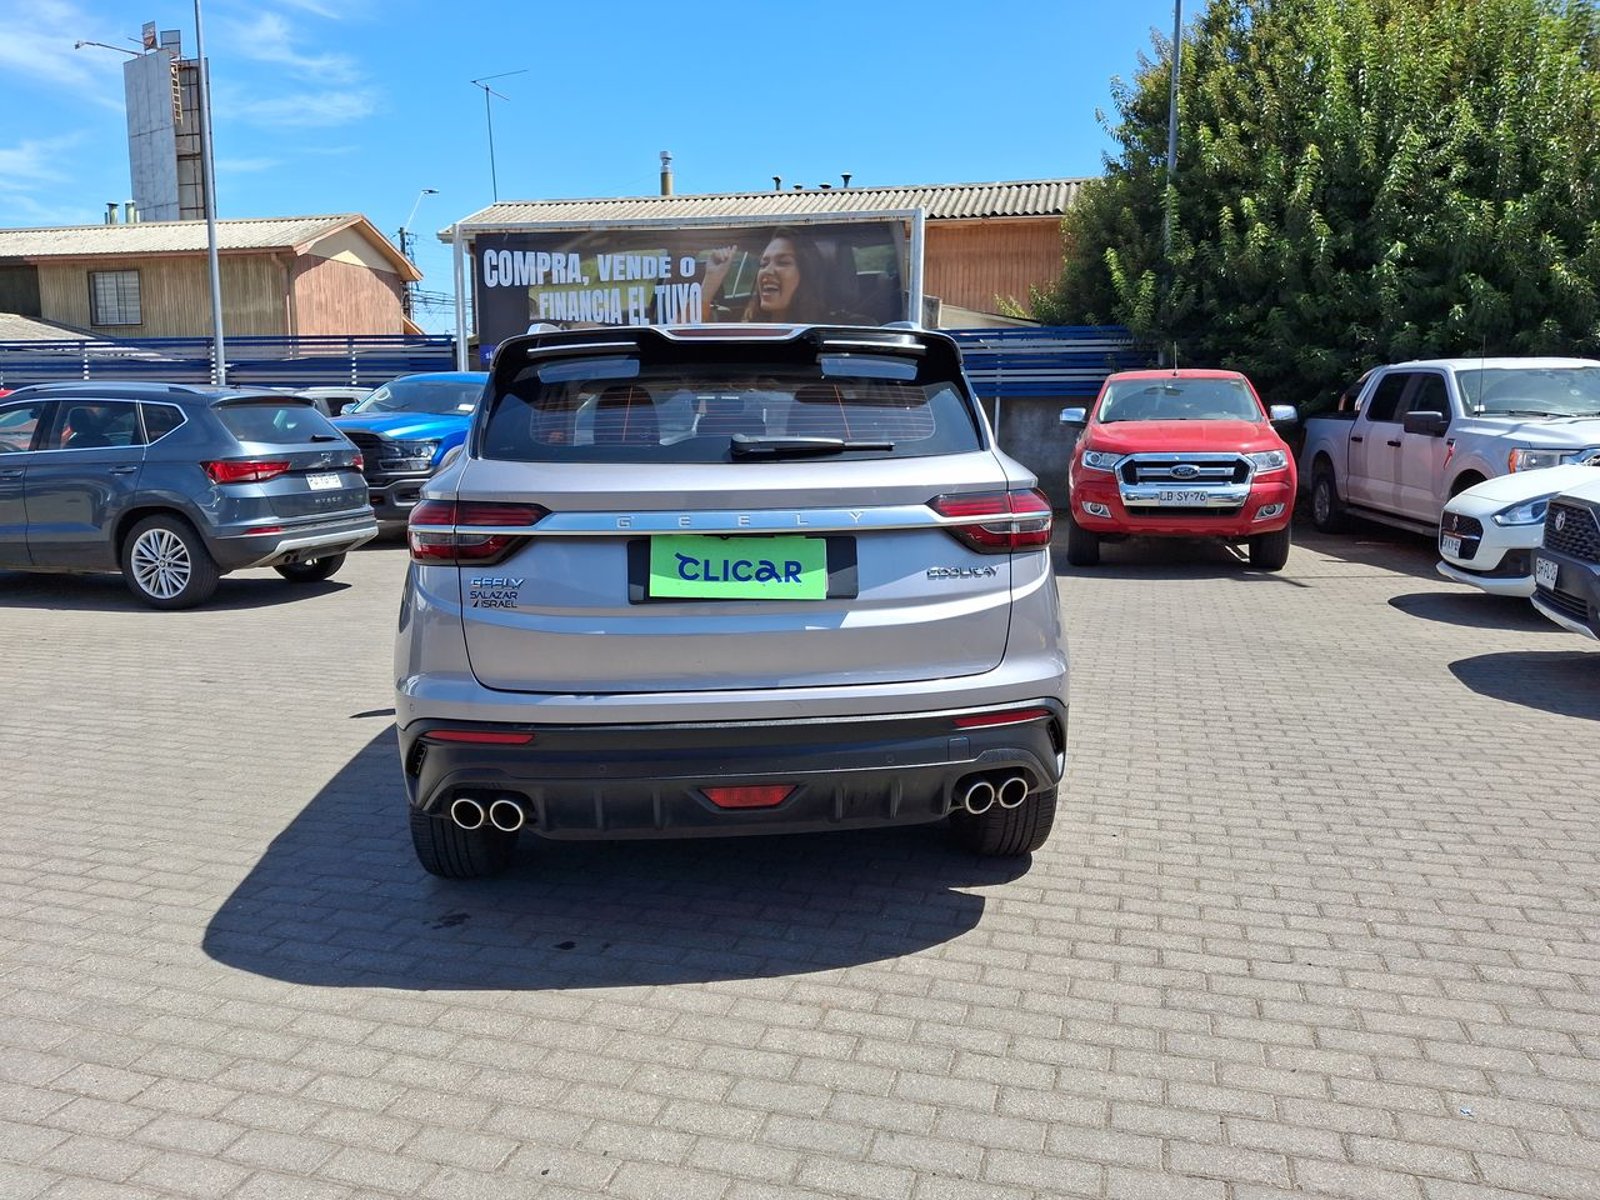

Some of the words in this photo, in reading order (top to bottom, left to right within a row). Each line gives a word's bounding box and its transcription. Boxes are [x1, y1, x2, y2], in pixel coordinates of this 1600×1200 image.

[483, 249, 589, 288] COMPRA,
[597, 254, 672, 282] VENDE
[679, 257, 696, 278] O
[538, 288, 623, 324] FINANCIA
[628, 285, 650, 326] EL
[654, 282, 702, 325] TUYO
[616, 511, 863, 529] GEELY
[469, 590, 519, 600] SALAZAR
